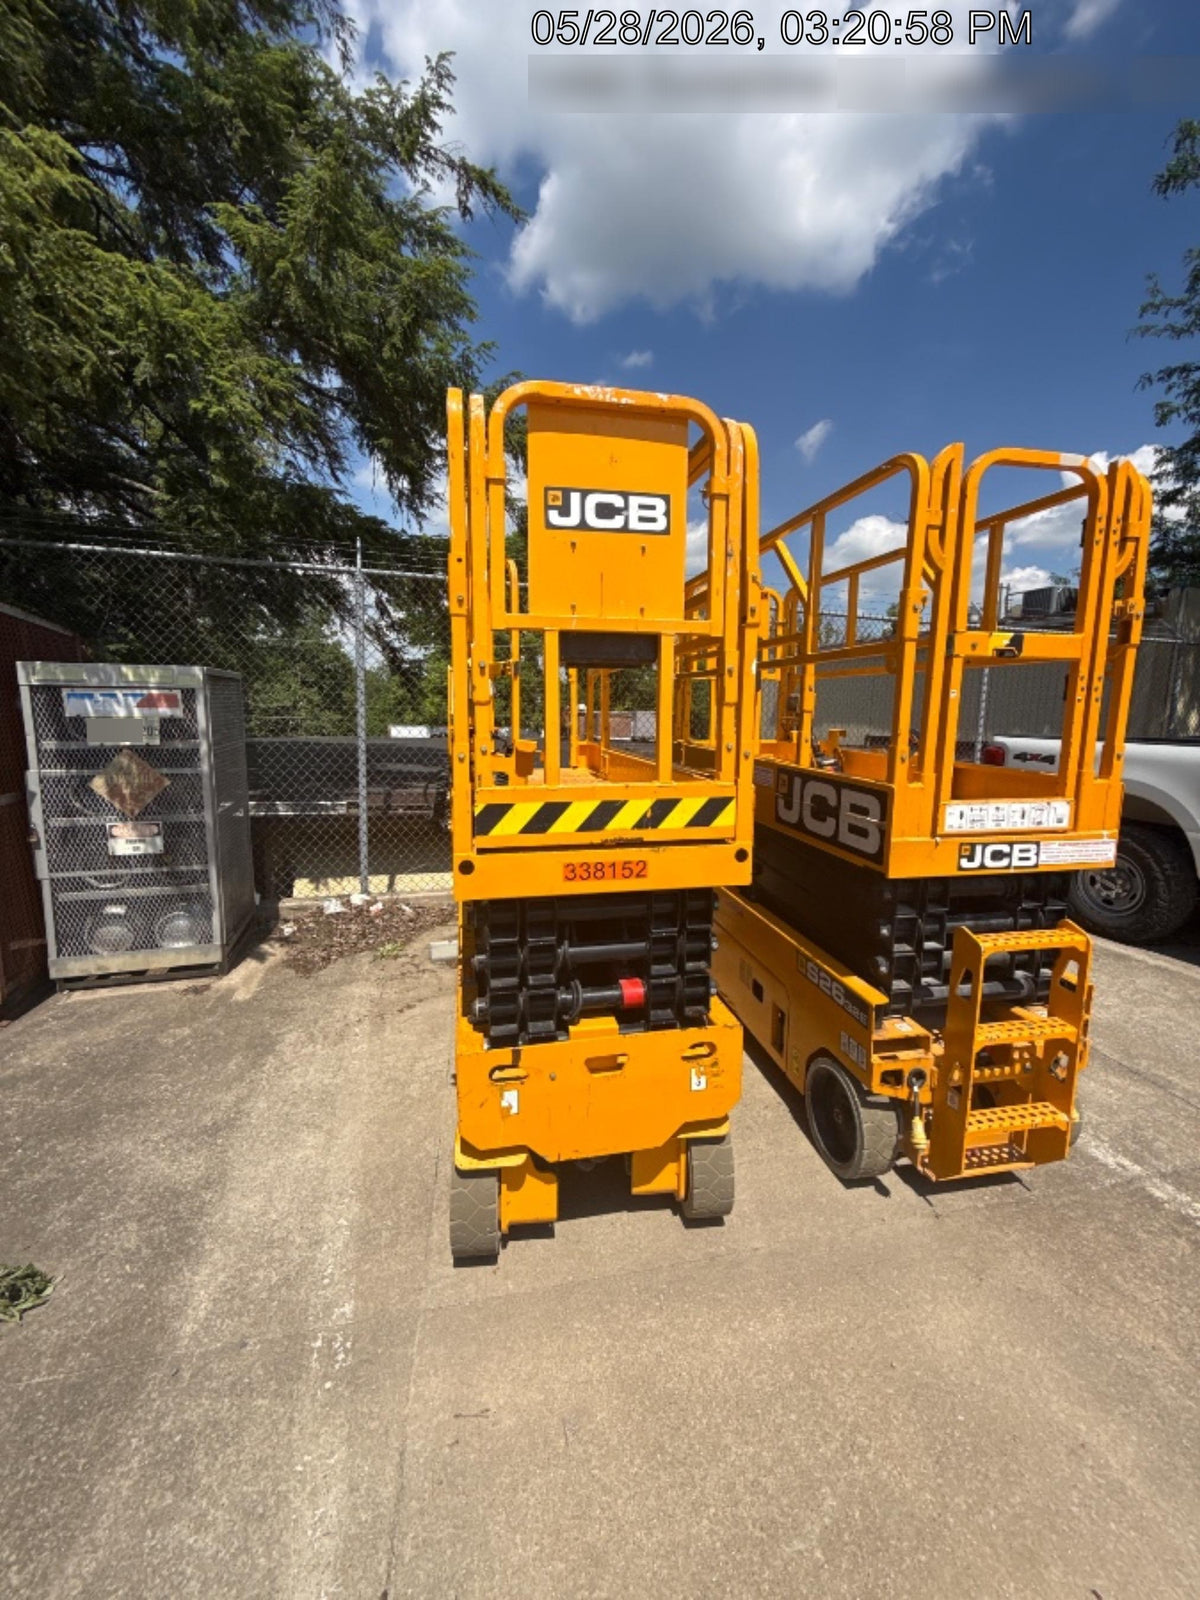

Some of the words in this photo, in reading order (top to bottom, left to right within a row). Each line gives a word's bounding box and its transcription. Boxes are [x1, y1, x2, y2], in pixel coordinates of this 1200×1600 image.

[547, 491, 668, 531] JCB
[776, 776, 881, 854] JCB
[564, 860, 647, 881] 338152
[959, 843, 1039, 869] JCB
